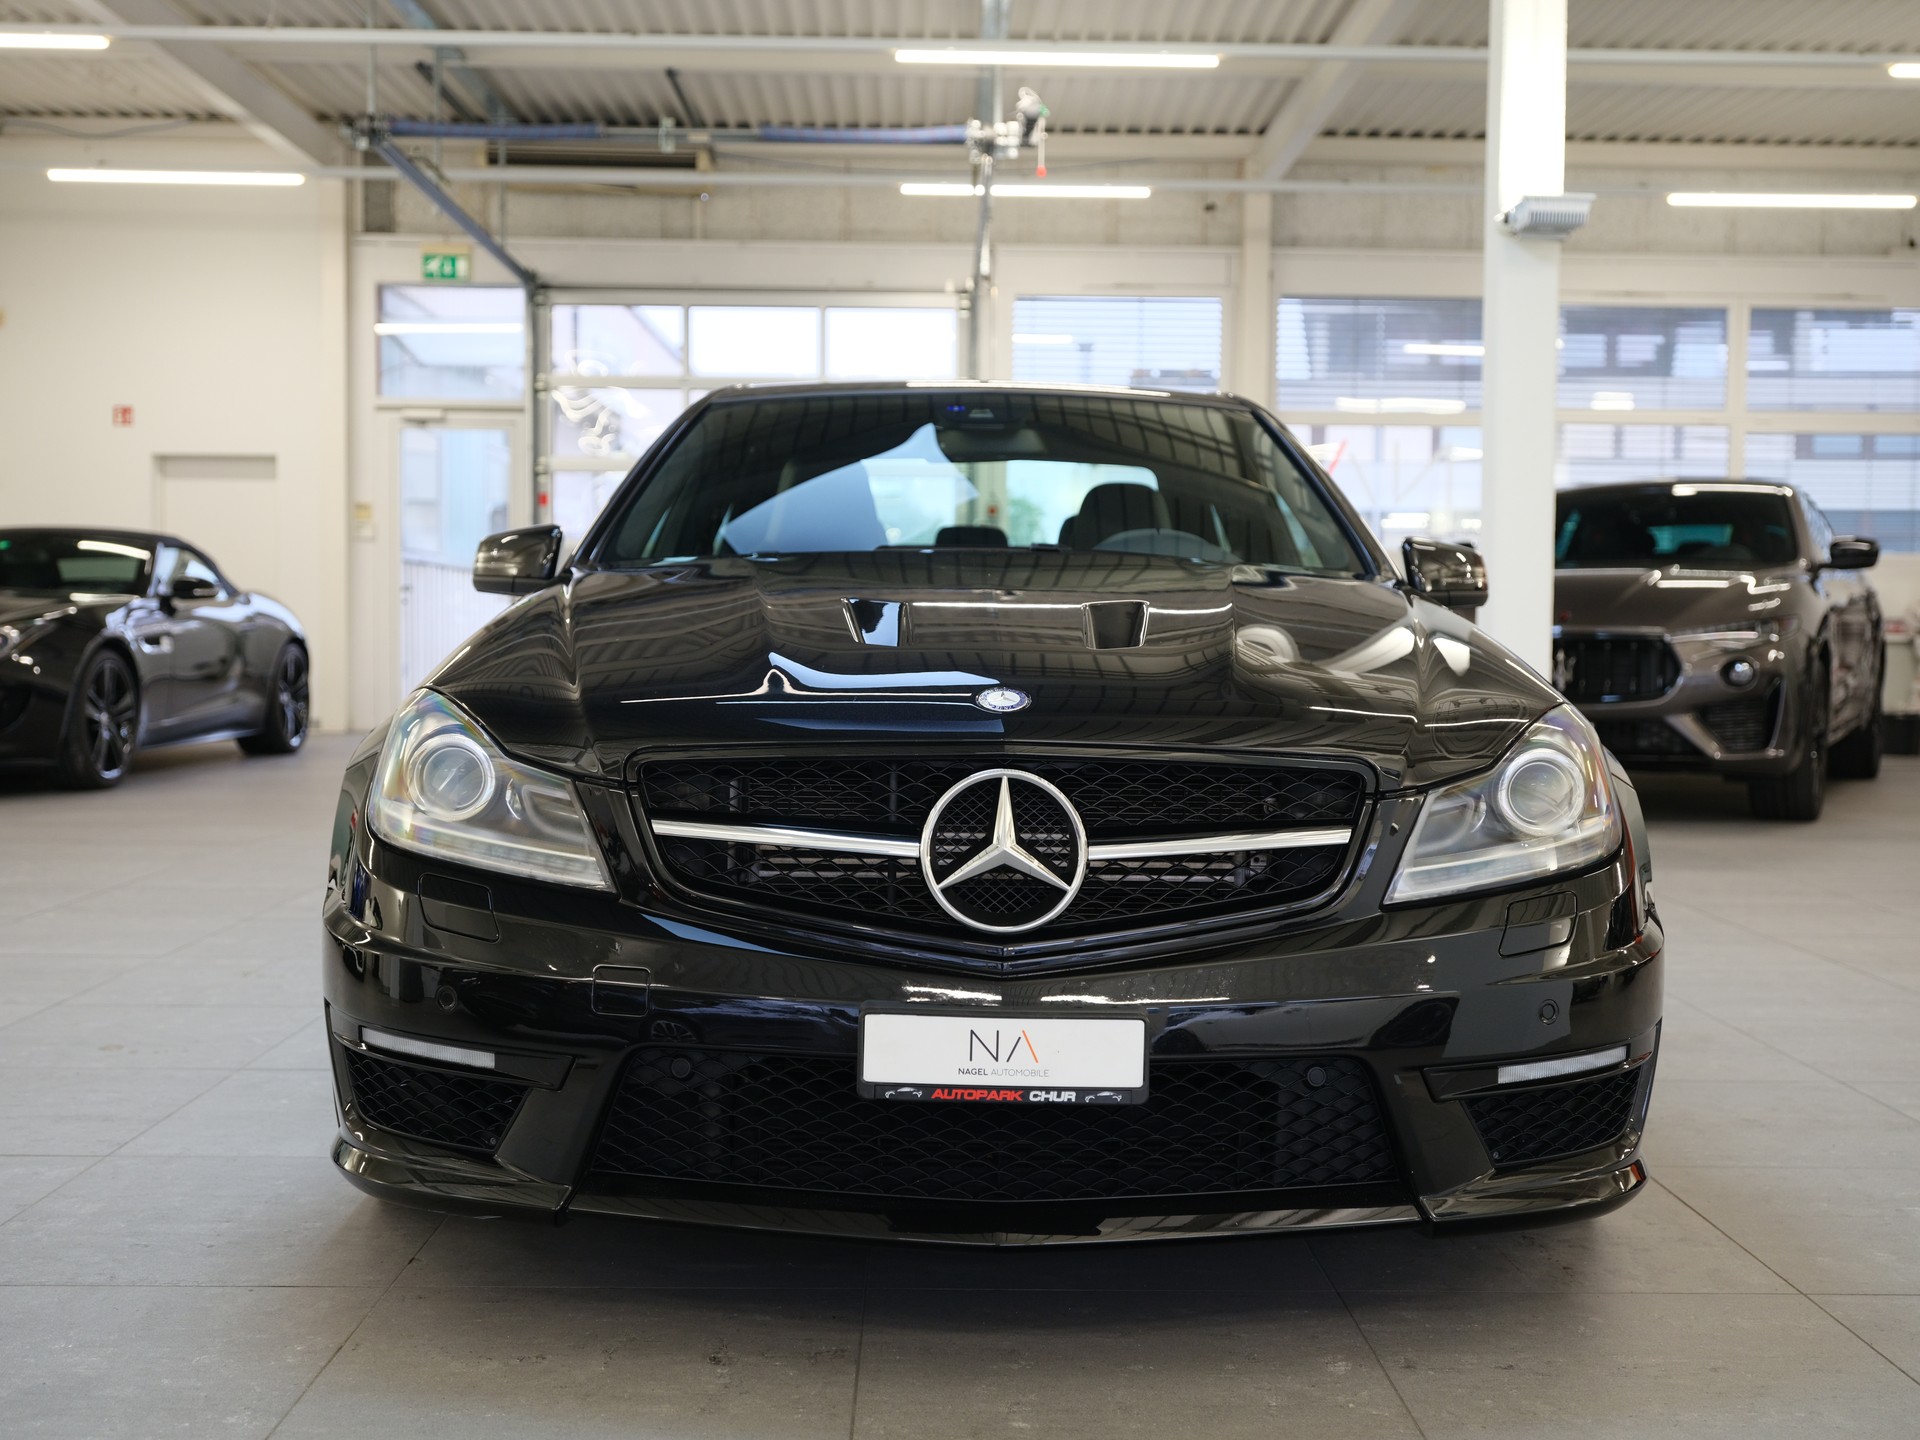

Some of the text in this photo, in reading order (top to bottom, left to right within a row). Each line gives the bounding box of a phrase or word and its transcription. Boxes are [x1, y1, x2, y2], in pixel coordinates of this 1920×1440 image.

[958, 1068, 1050, 1077] NAGEL AUTOMOBILE
[931, 1088, 1076, 1102] AUTOPARK CHUR
